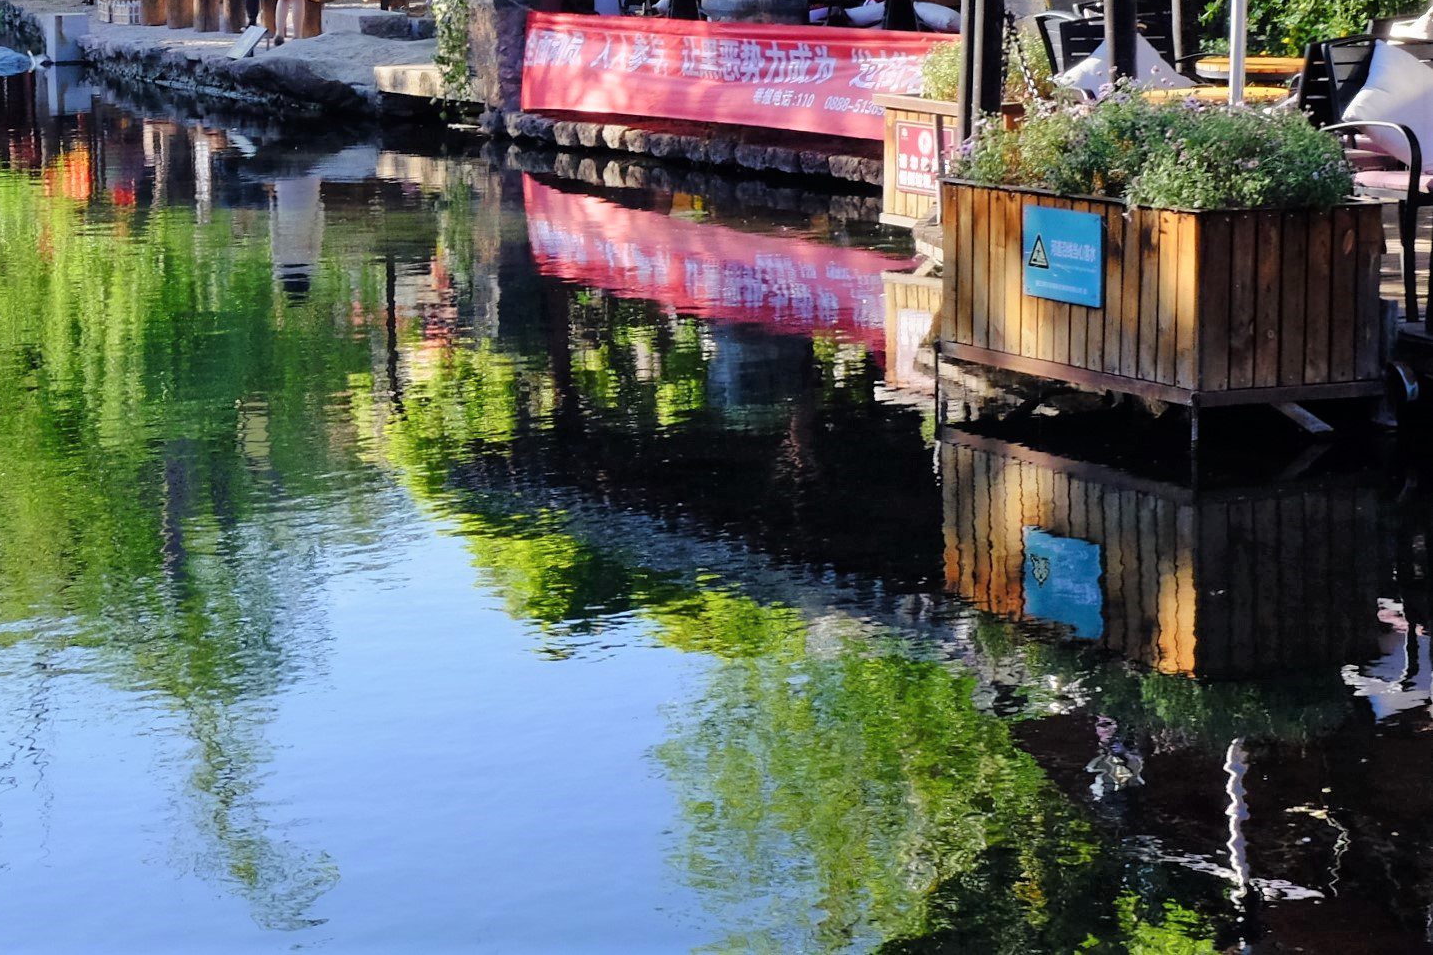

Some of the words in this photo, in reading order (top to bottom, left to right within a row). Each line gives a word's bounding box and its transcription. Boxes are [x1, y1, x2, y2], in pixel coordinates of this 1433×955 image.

[590, 32, 669, 75] 人人参与
[680, 36, 837, 84] 让黑恶势力成为
